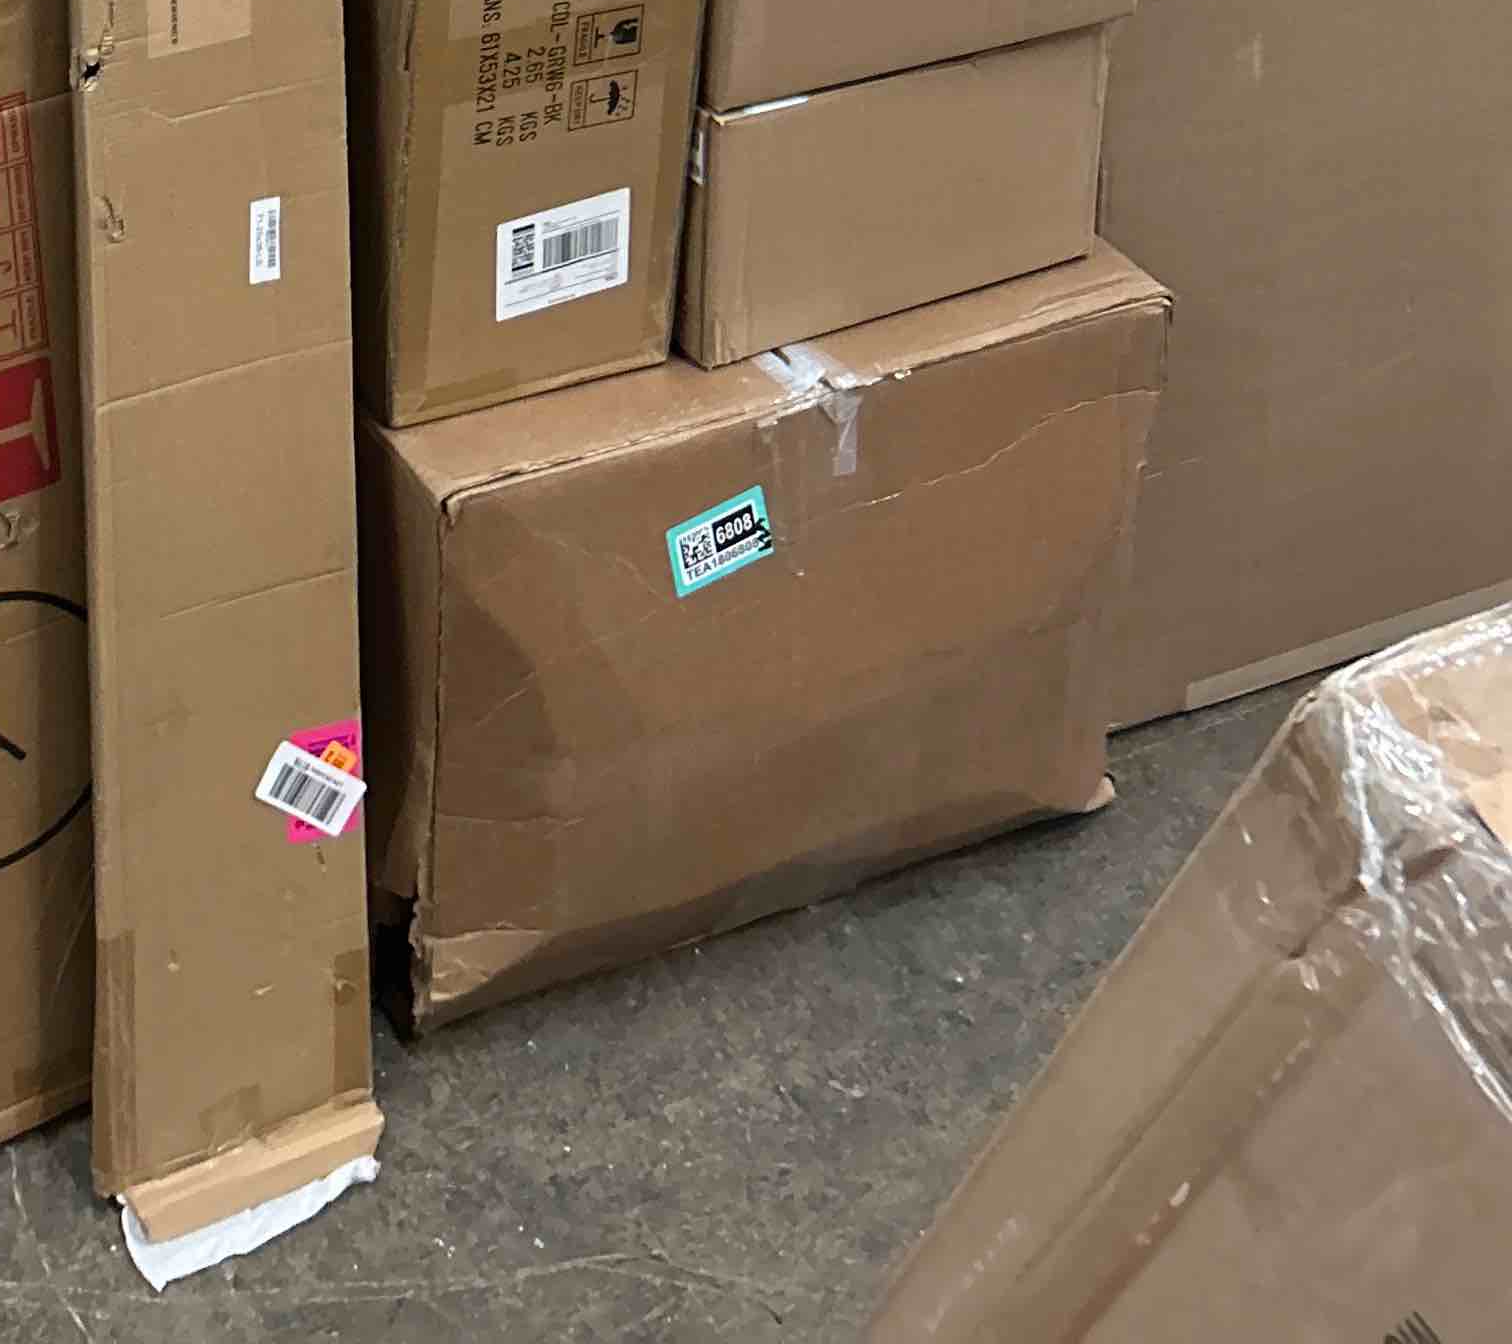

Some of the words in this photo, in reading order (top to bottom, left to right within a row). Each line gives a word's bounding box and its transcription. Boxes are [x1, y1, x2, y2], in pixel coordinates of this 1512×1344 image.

[476, 32, 500, 113] 61X53X21
[474, 122, 491, 145] CM
[496, 116, 514, 146] KGS
[520, 112, 537, 142] KGS
[715, 512, 753, 544] 6808
